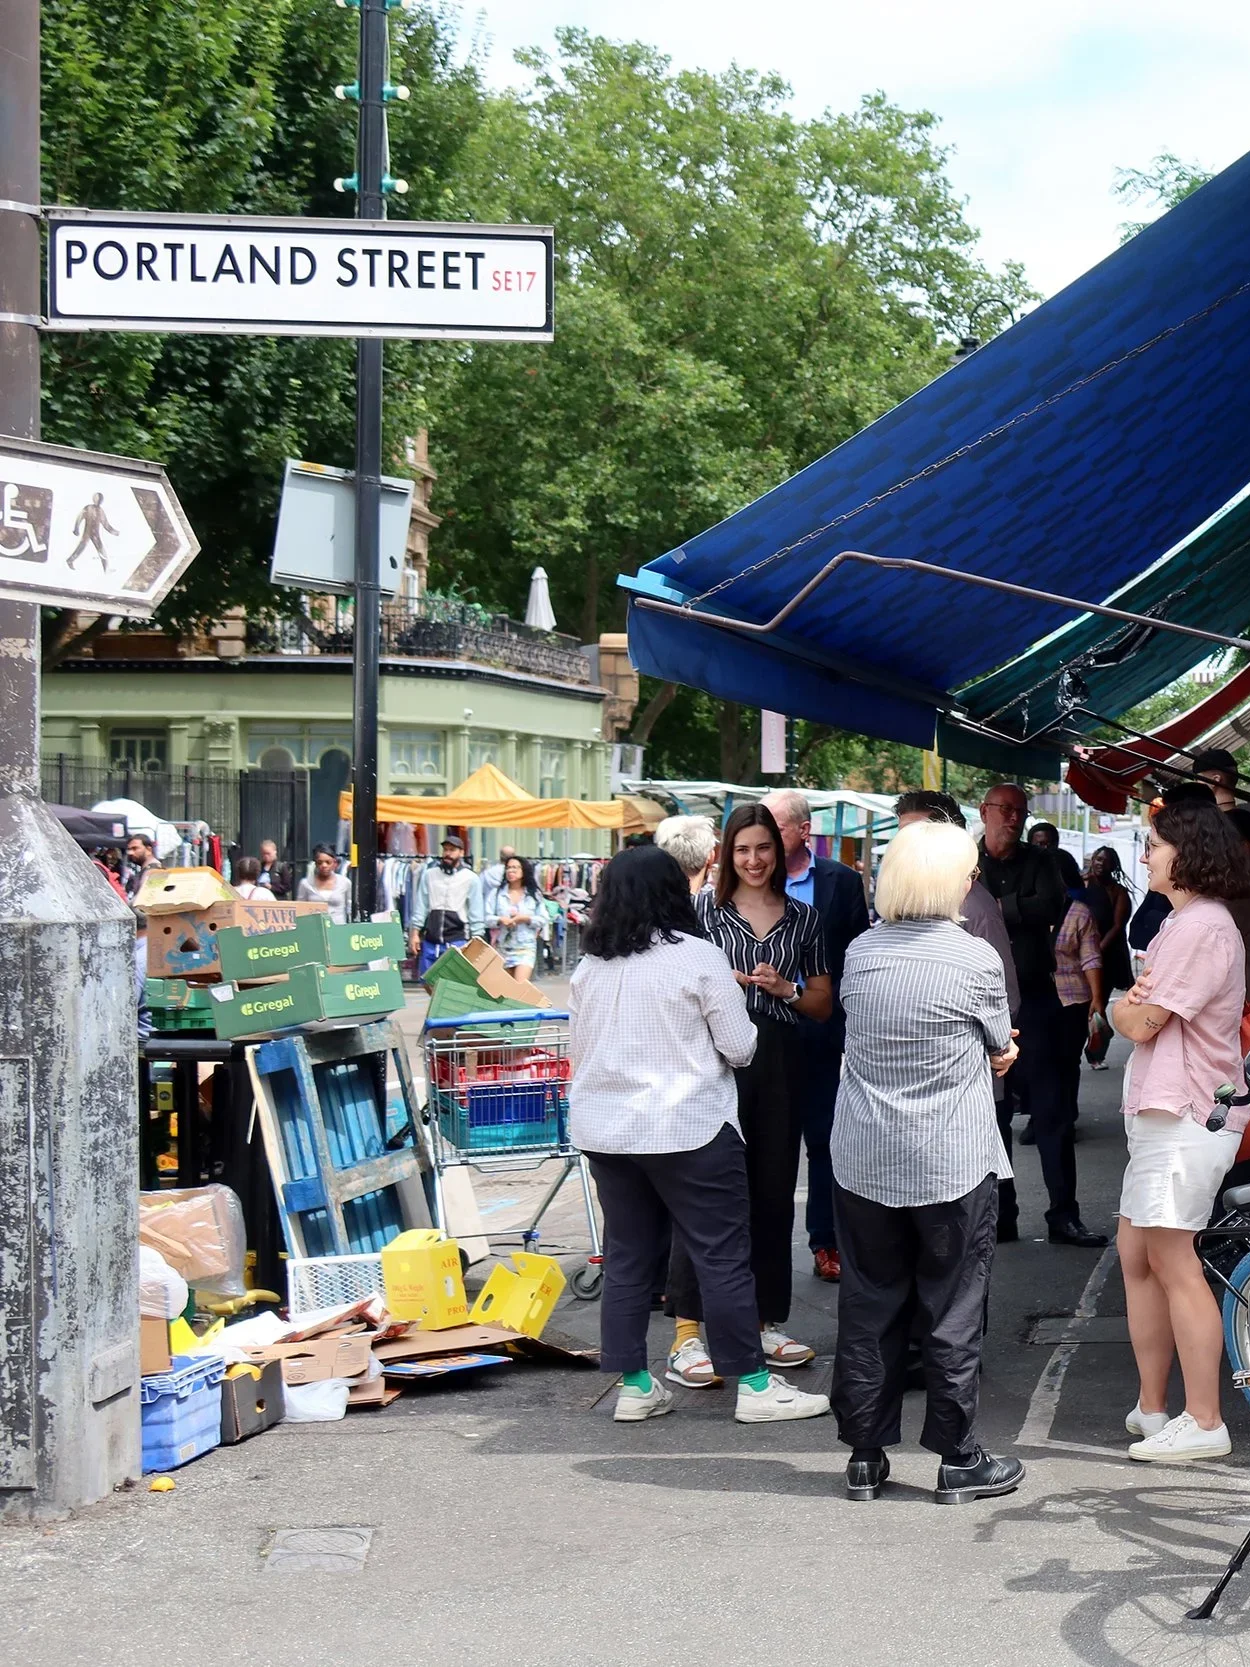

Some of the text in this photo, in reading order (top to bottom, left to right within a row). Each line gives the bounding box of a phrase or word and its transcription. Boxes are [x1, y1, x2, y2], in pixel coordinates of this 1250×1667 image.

[65, 240, 537, 293] PORTLAND STREET SE17
[258, 941, 300, 959] Gregal
[359, 934, 384, 950] Gregal
[354, 982, 381, 1000] Gregal
[253, 995, 295, 1014] Gregal
[441, 1256, 459, 1269] AIR
